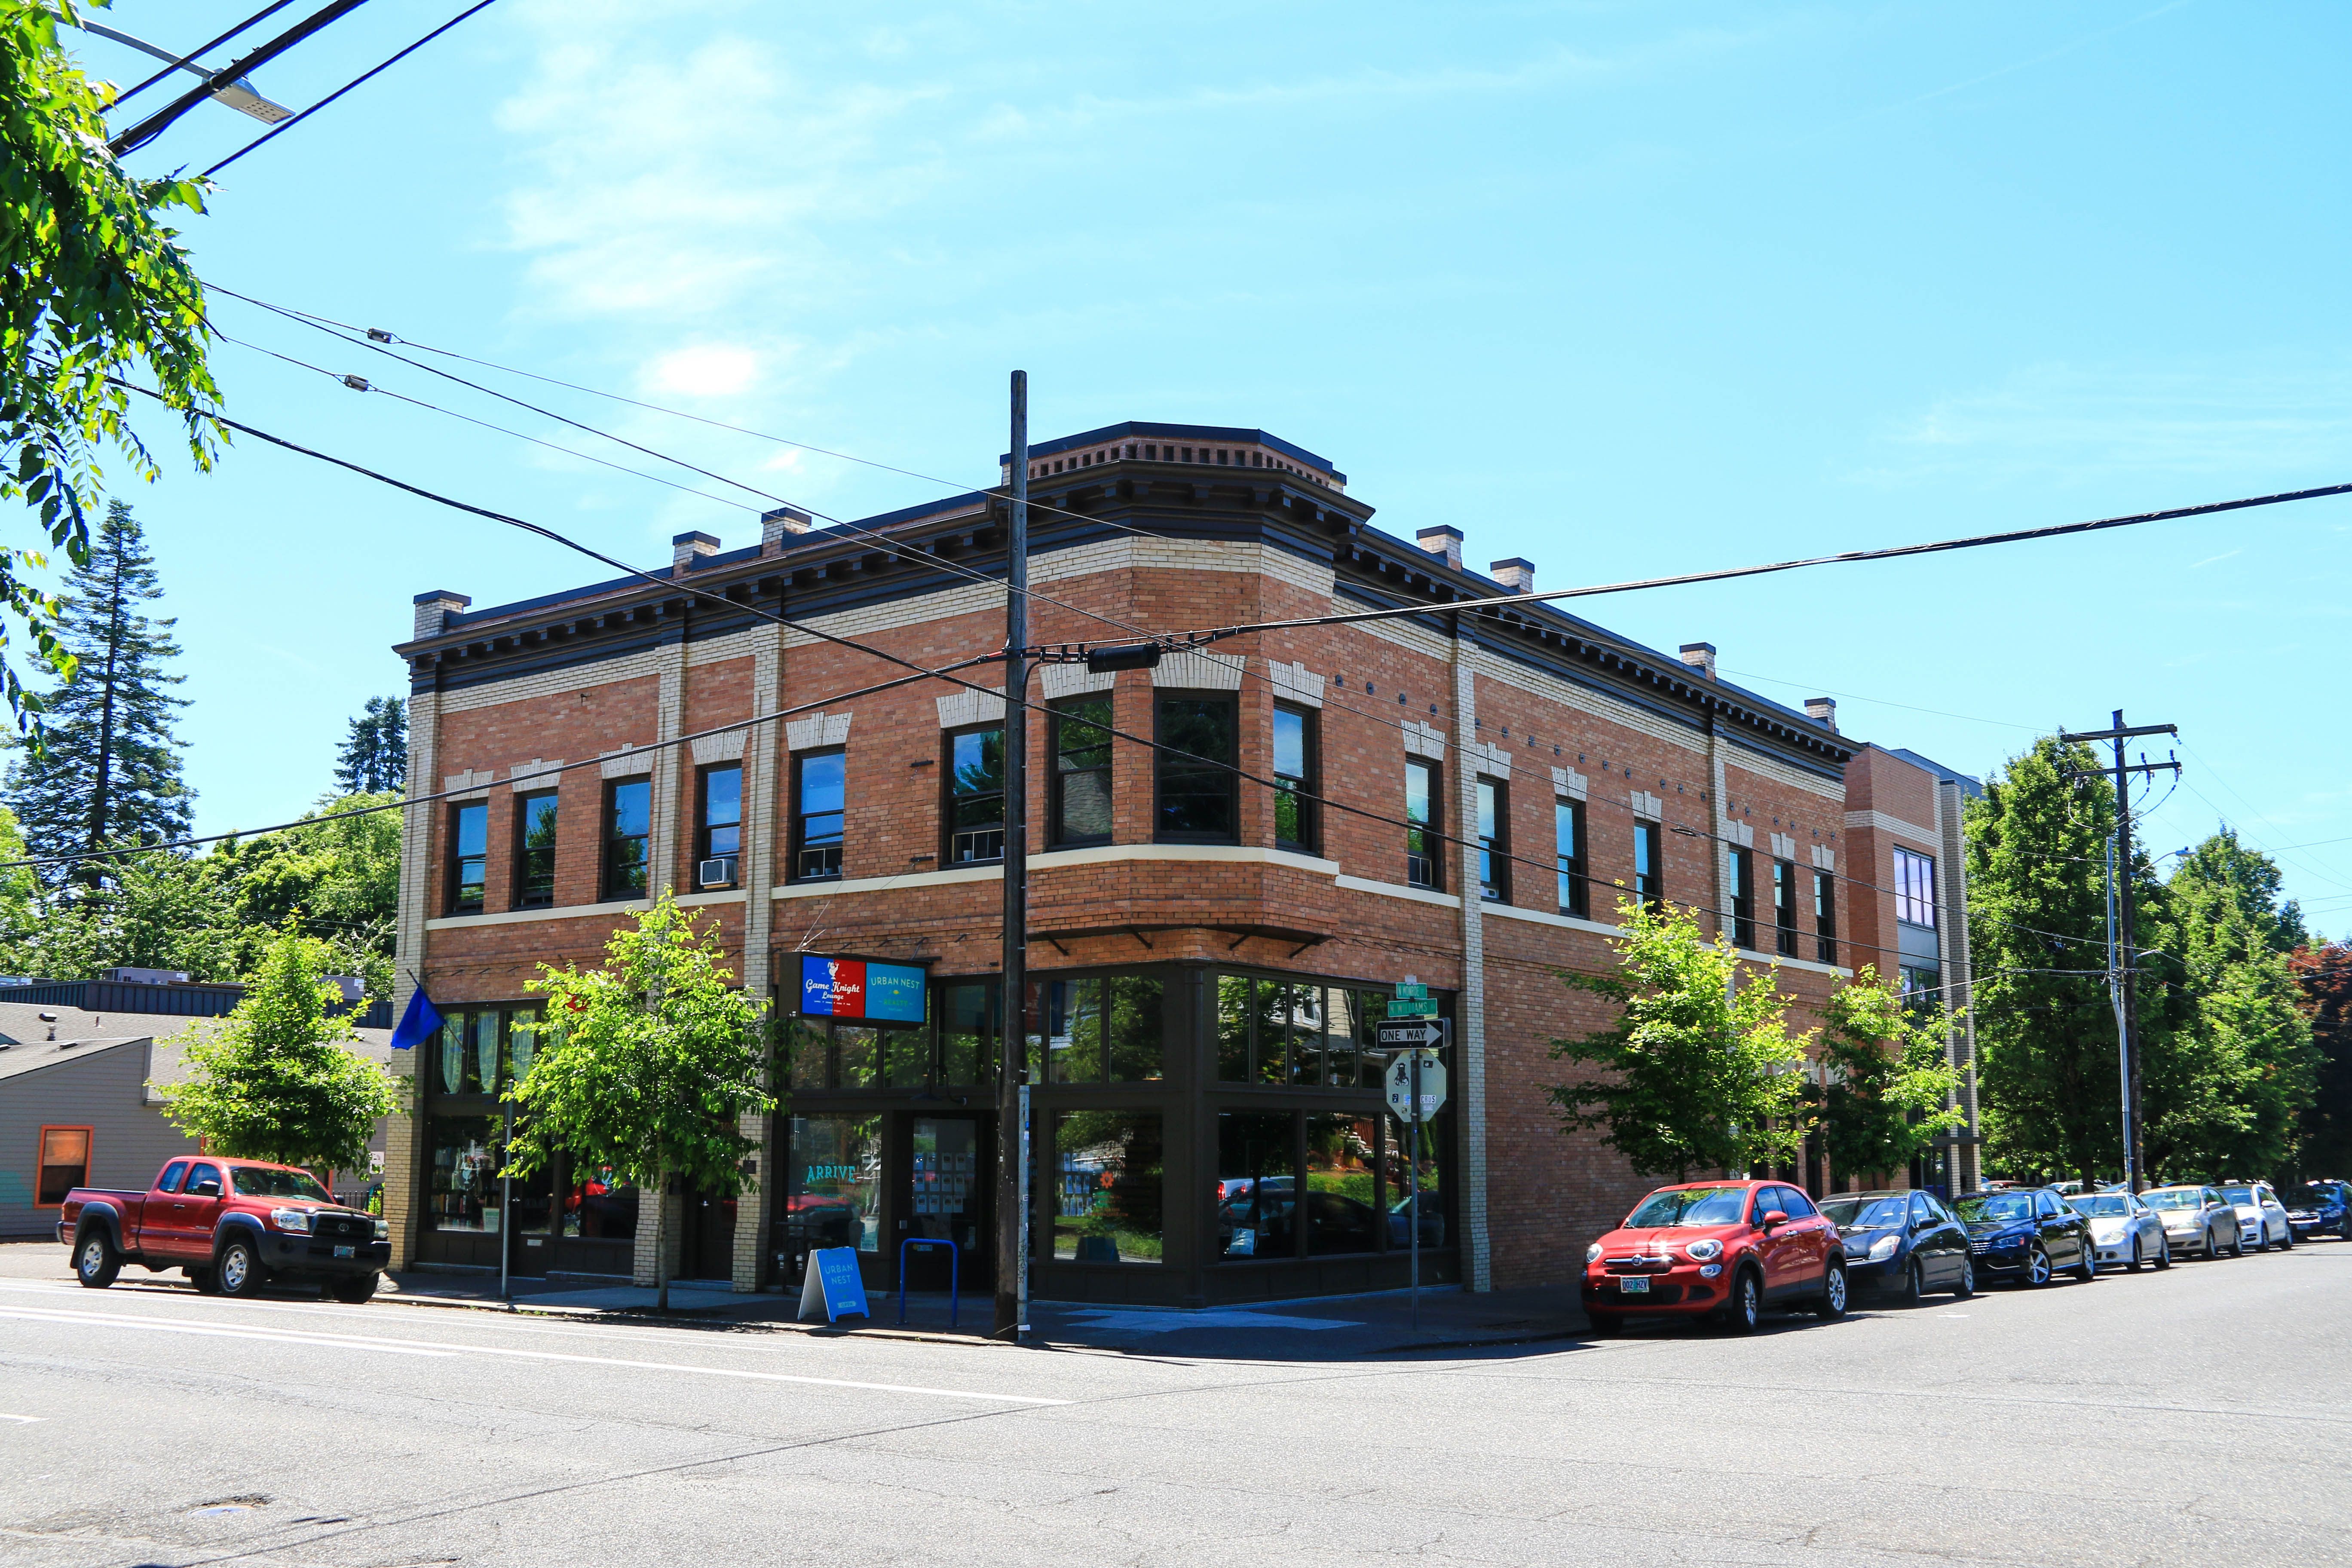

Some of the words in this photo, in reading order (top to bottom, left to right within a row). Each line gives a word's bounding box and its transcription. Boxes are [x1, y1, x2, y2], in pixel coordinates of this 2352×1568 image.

[805, 979, 830, 993] Game
[831, 981, 860, 994] Knight
[871, 977, 899, 986] URBAN
[901, 978, 920, 990] NEST
[821, 991, 844, 1001] Lounge
[1398, 986, 1402, 996] N
[1397, 1002, 1427, 1013] WILLIAMS
[1381, 1030, 1400, 1041] ONE
[1406, 1029, 1426, 1040] WAY
[806, 1166, 856, 1183] ARRIVE
[824, 1264, 853, 1274] URBAN
[831, 1275, 851, 1285] NEST
[1623, 1280, 1633, 1289] 002
[1636, 1280, 1647, 1289] HZV
